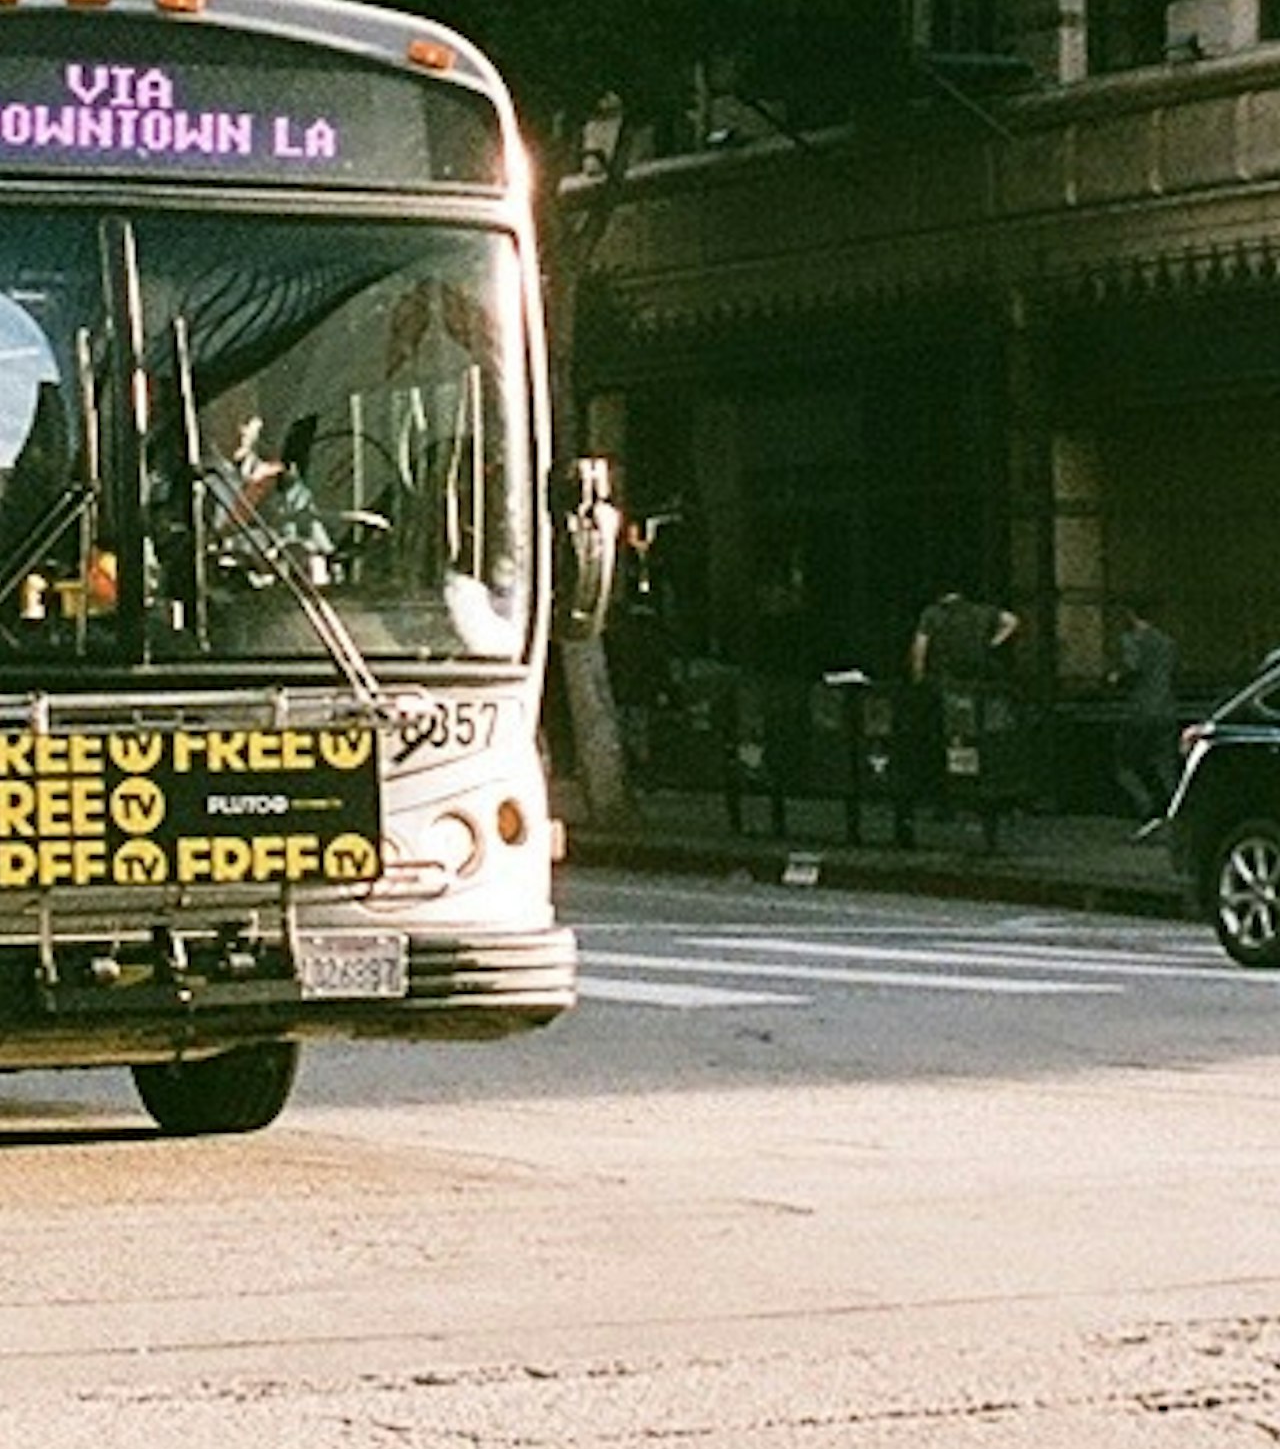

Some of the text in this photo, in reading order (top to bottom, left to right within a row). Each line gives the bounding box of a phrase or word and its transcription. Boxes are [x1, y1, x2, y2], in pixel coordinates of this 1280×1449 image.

[66, 64, 173, 108] VIA
[273, 117, 337, 158] LA
[173, 730, 316, 772] FREE
